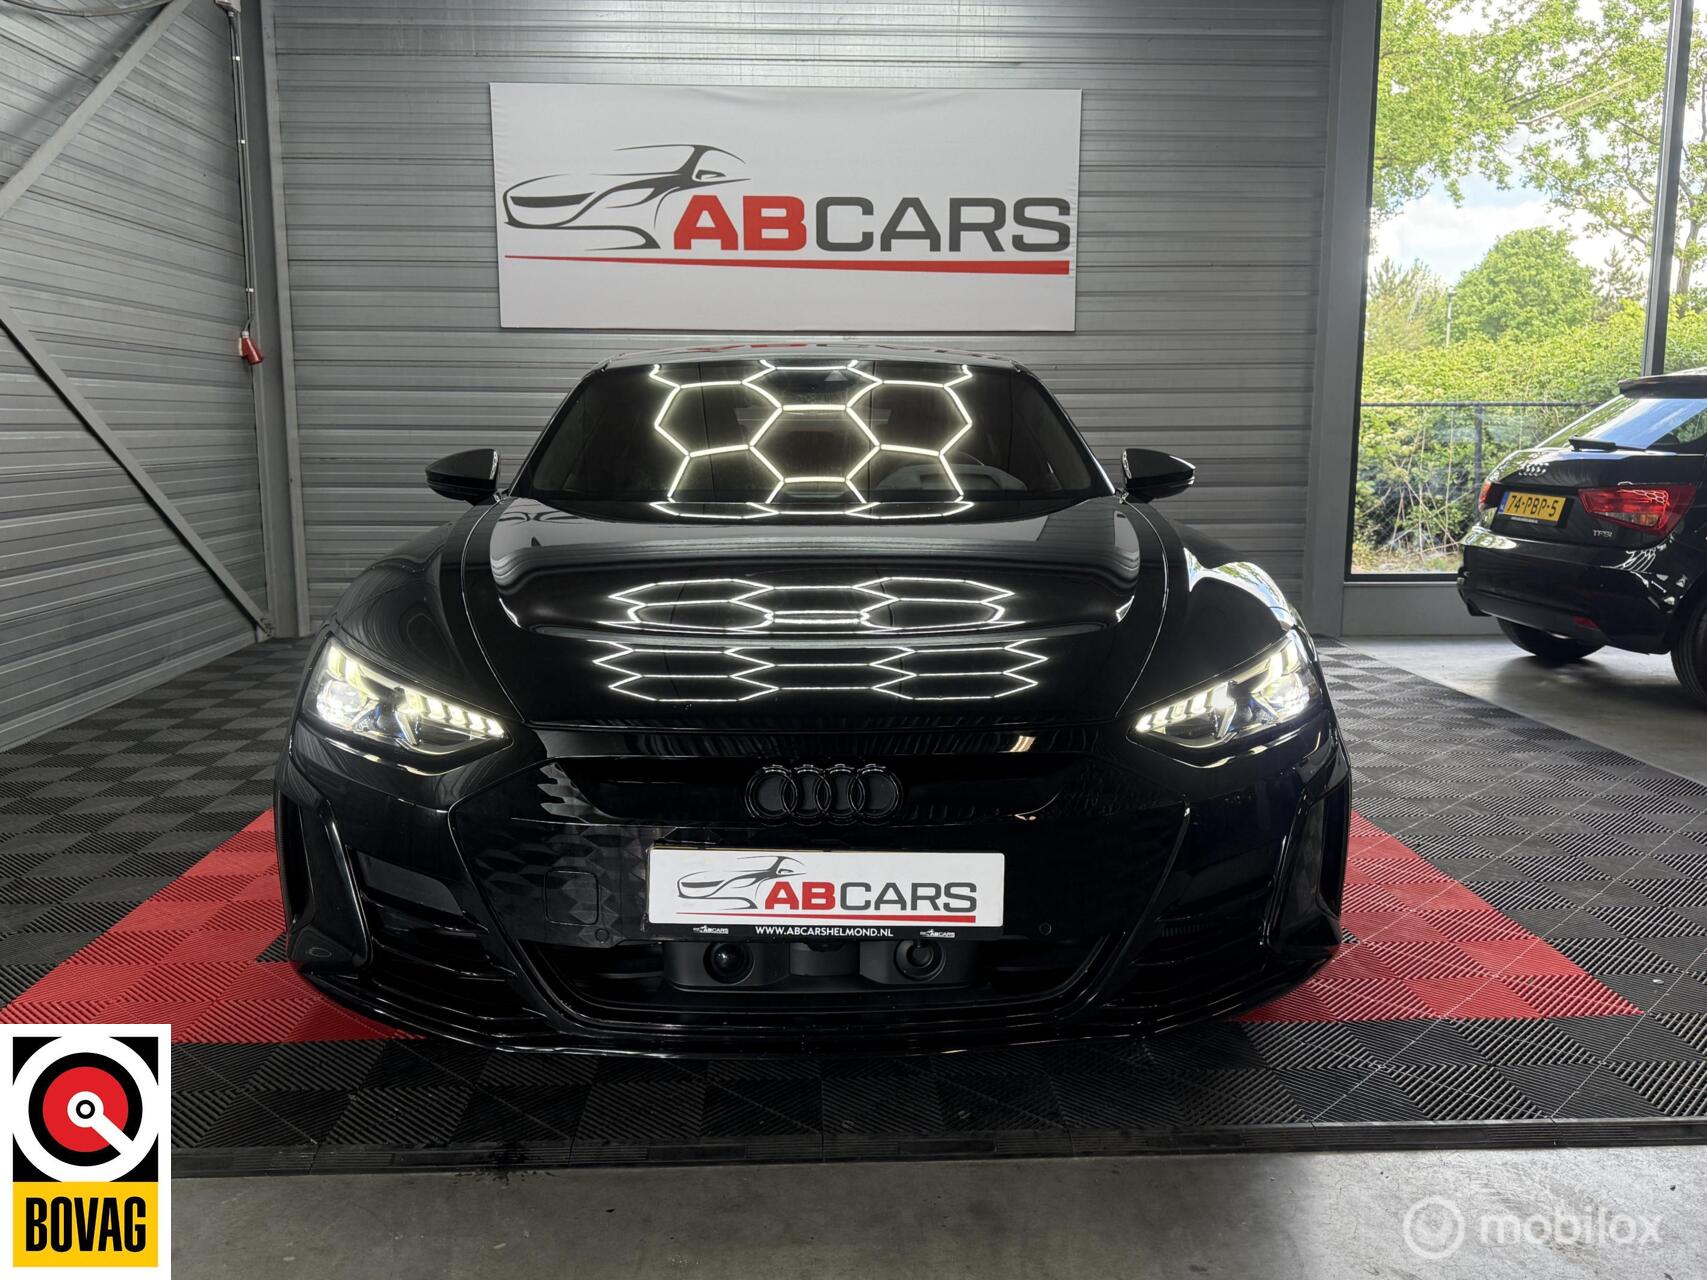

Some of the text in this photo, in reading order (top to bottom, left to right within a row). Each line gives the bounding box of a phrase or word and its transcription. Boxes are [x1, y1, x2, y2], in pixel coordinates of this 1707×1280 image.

[673, 194, 1071, 253] ABCARS
[765, 881, 977, 913] ABCARS
[755, 925, 894, 937] WWW.ABCARSHELMOND.NL
